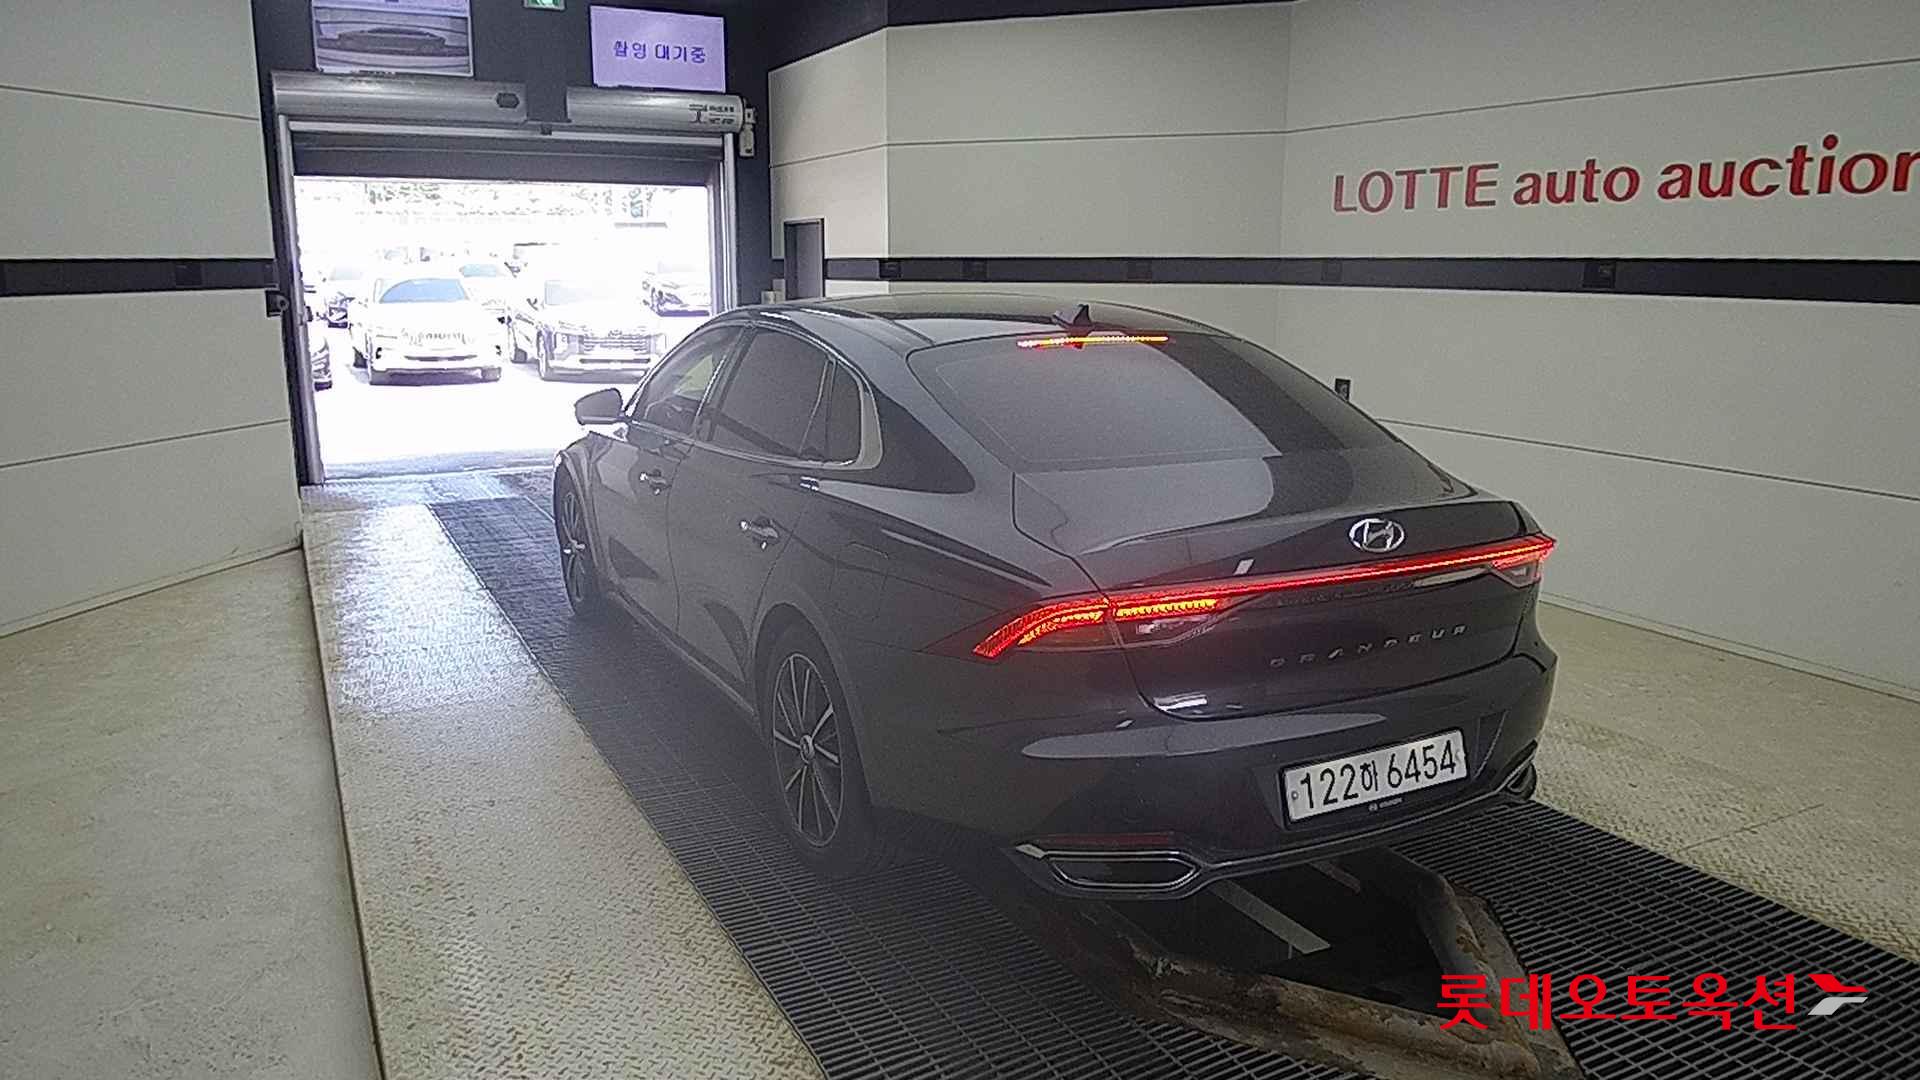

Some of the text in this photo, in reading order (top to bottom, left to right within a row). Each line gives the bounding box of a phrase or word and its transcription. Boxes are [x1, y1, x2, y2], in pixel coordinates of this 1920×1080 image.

[655, 43, 706, 64] 대기중
[1333, 163, 1499, 213] LOTTE
[1513, 158, 1641, 206] auto
[1301, 740, 1456, 809] 122하 6454
